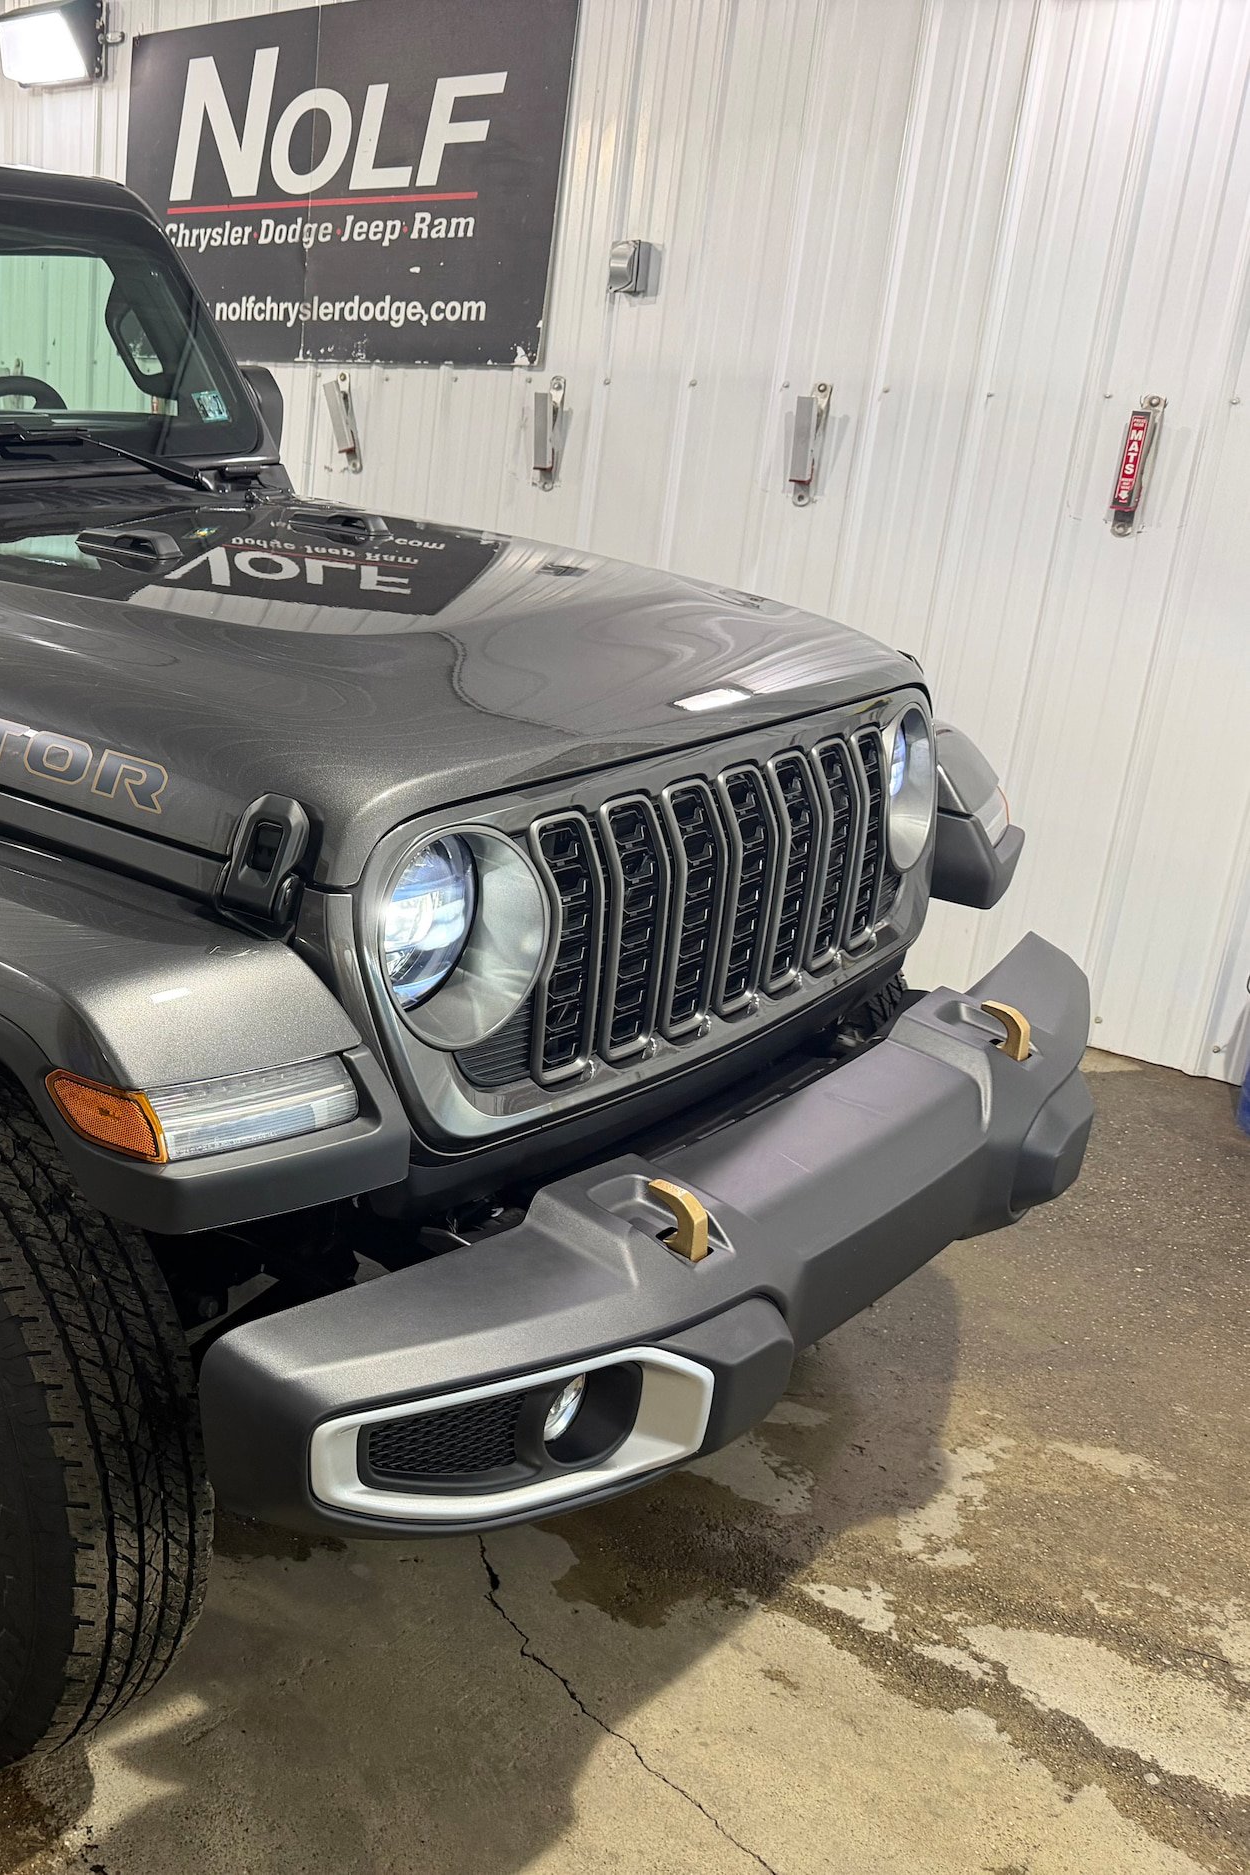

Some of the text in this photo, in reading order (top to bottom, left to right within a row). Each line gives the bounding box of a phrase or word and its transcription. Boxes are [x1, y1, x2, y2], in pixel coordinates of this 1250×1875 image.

[169, 46, 508, 201] NOLF
[258, 217, 333, 249] Dodge
[341, 215, 401, 246] Jeep
[410, 212, 475, 239] Ram
[1123, 429, 1143, 475] MATS
